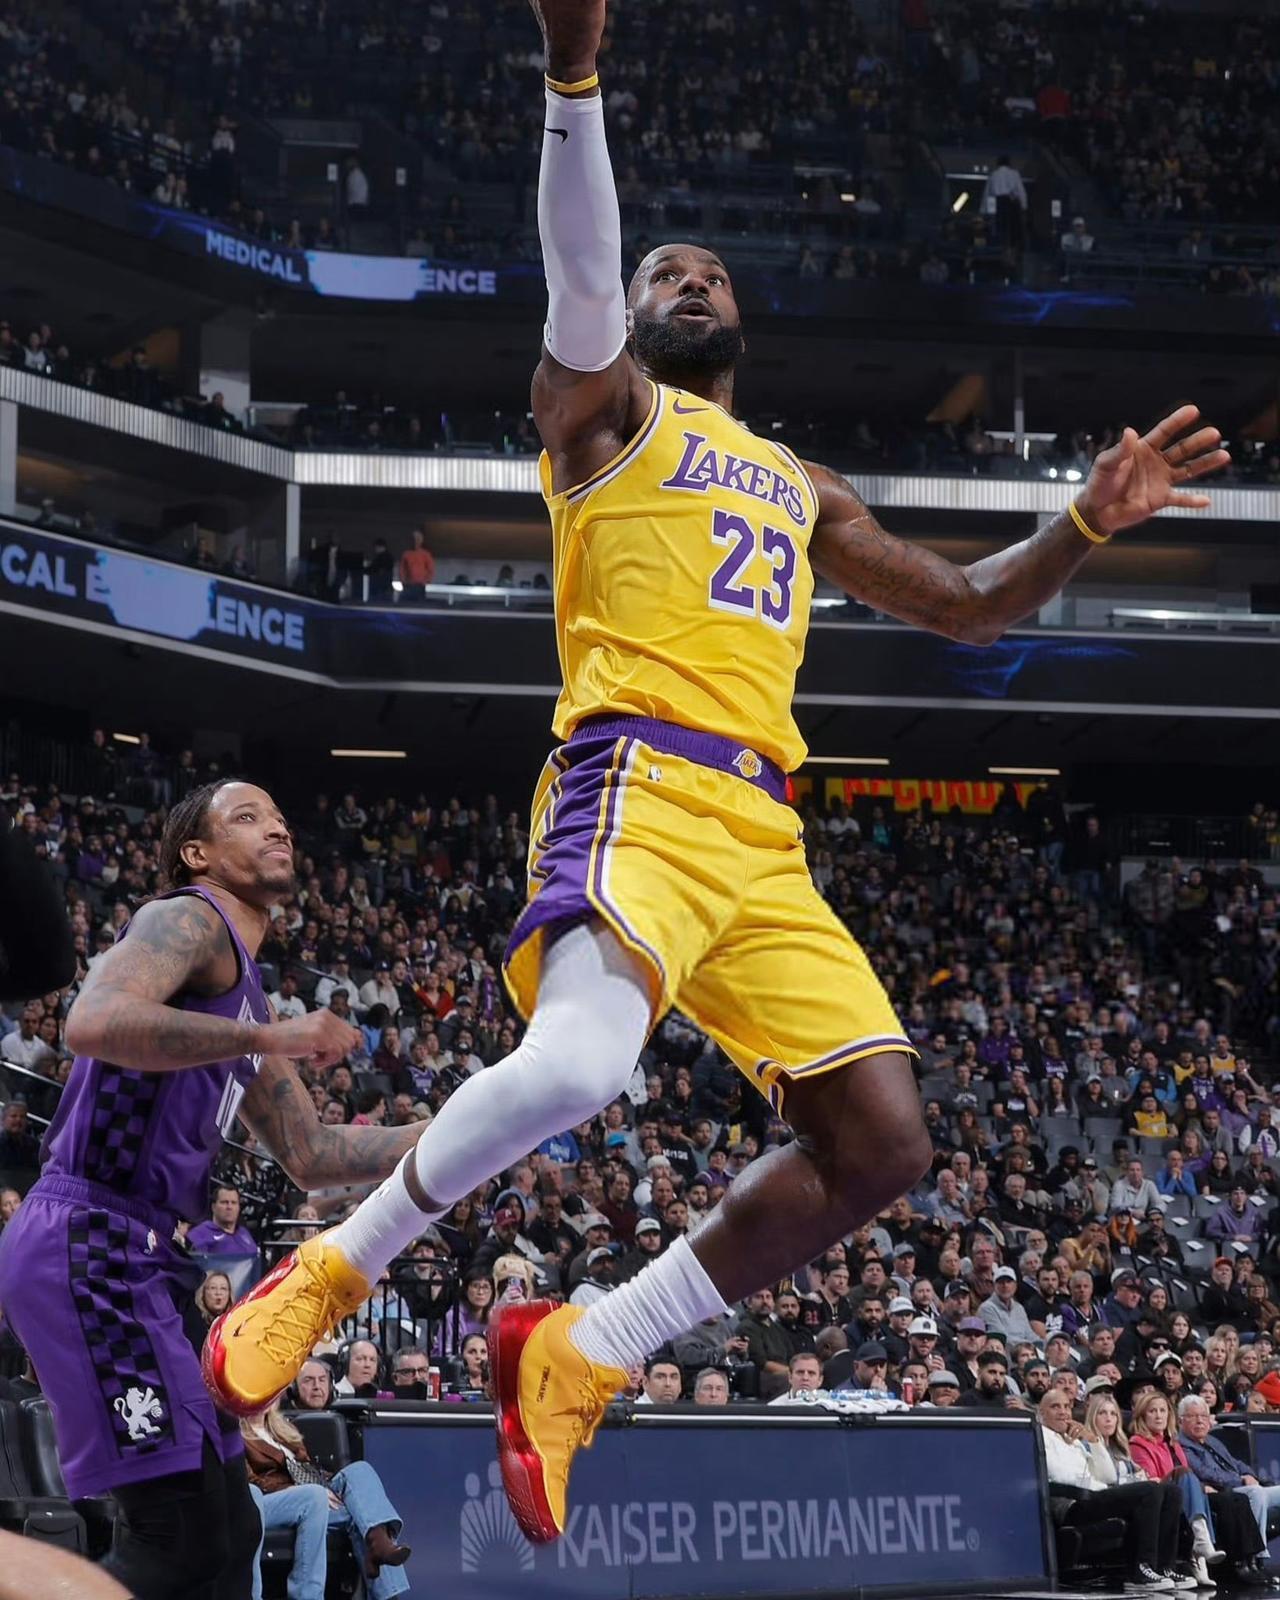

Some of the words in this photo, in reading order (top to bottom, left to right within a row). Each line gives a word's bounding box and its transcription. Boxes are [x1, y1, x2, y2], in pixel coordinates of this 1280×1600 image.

[206, 229, 302, 283] MEDICAL
[659, 431, 807, 527] LAKERS
[0, 543, 77, 597] CAL
[708, 507, 796, 632] 23
[556, 1501, 700, 1568] KAISER
